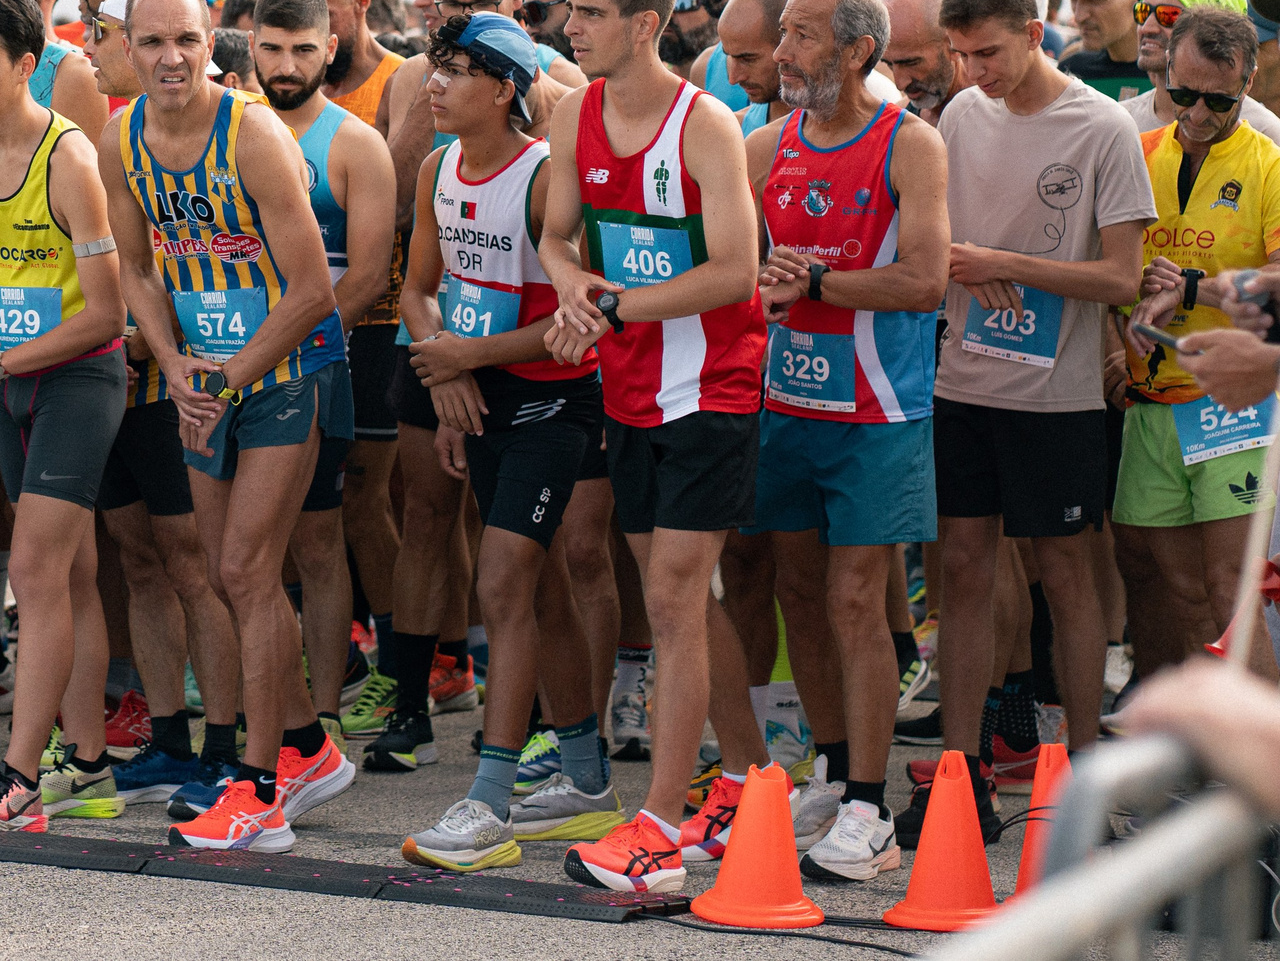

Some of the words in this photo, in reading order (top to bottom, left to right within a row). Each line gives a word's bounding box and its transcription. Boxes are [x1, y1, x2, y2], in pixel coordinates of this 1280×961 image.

[154, 190, 217, 225] LKO
[630, 226, 655, 242] CORRIDA
[622, 247, 673, 277] 406
[0, 288, 25, 300] CORRIDA
[200, 291, 227, 304] CORRIDA
[196, 311, 246, 337] 574
[451, 303, 492, 337] 491
[983, 307, 1036, 335] 203
[790, 330, 814, 347] CORRIDA
[966, 332, 982, 342] 10Km
[1003, 333, 1024, 342] GOMES
[782, 350, 830, 382] 329
[787, 379, 801, 387] JOÃO
[800, 381, 823, 390] SANTOS
[1200, 403, 1258, 432] 524
[1204, 427, 1231, 440] JOAQUIM
[1230, 421, 1261, 433] CARREIRA
[1186, 442, 1206, 454] 10Km
[532, 505, 546, 523] CC
[473, 825, 502, 848] HOKA
